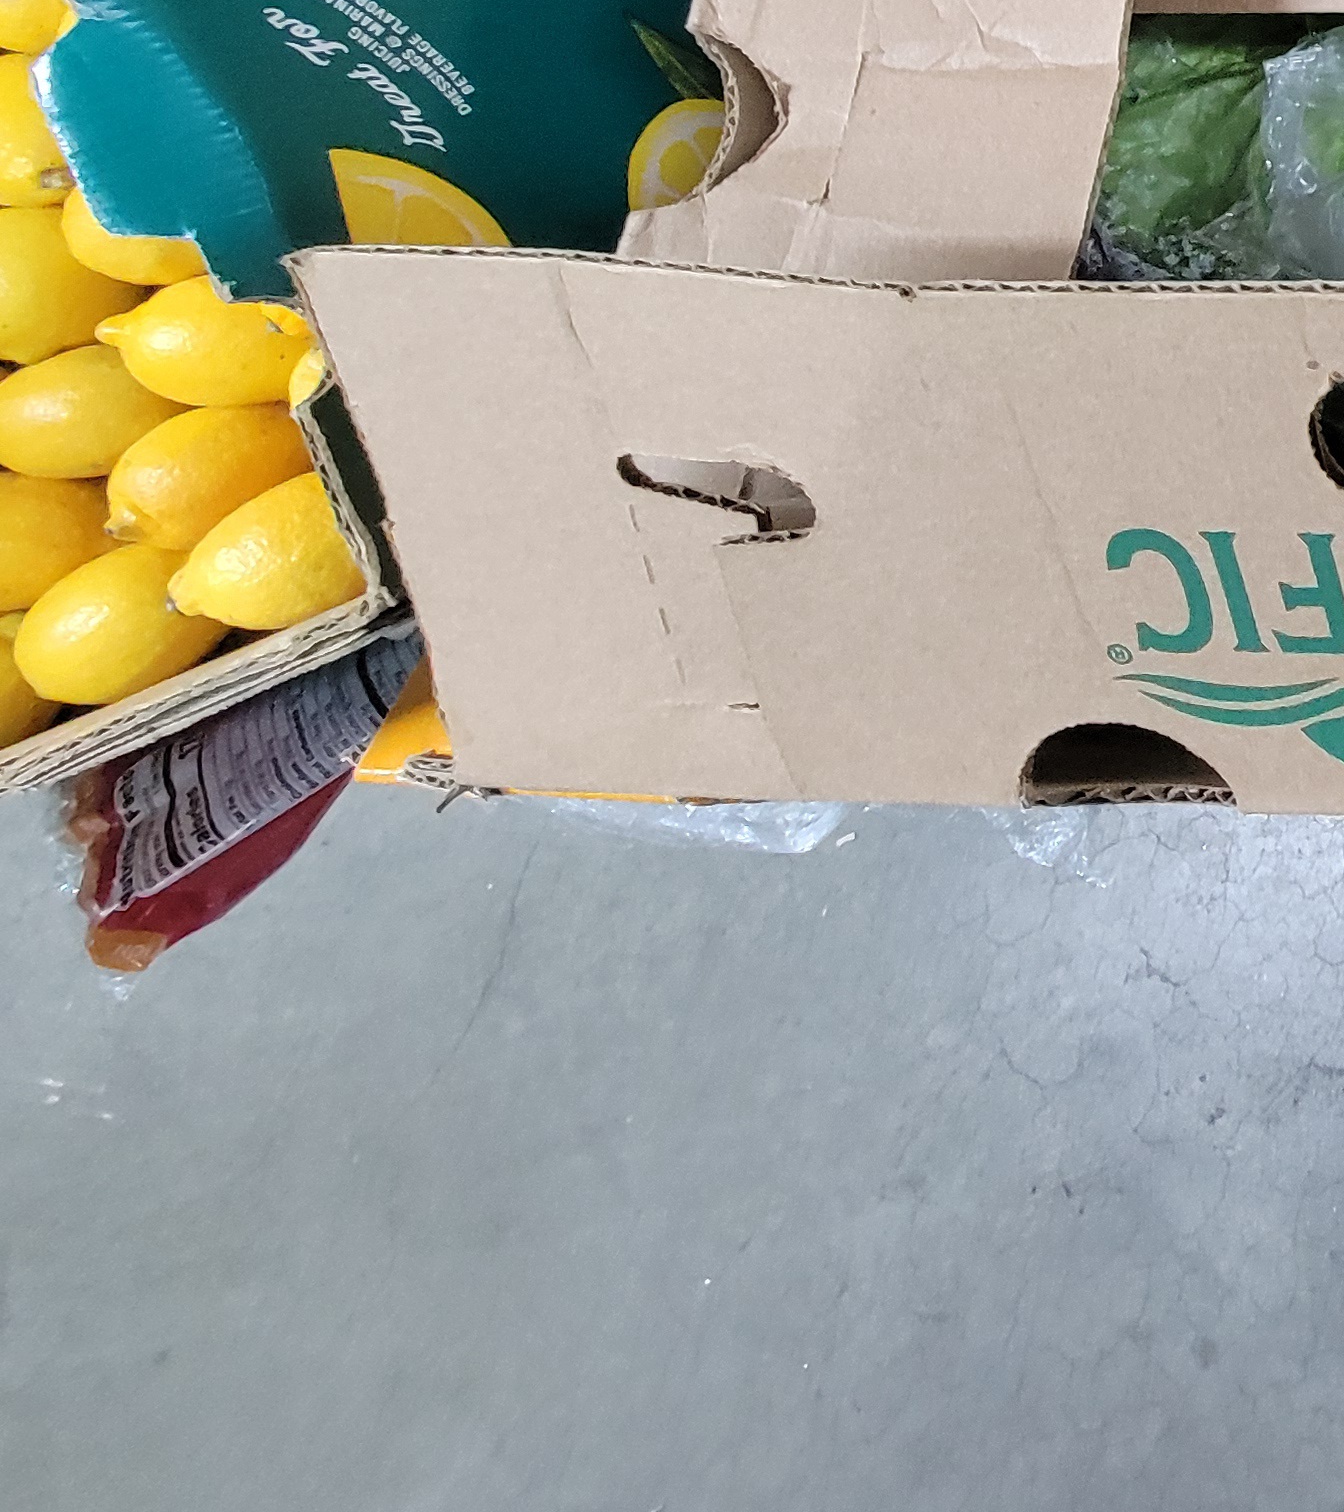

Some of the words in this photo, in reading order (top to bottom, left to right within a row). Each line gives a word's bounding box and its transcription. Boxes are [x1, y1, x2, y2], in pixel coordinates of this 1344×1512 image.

[262, 7, 349, 66] For
[348, 26, 410, 73] JUICING
[408, 33, 475, 95] BEVERAGE
[401, 48, 472, 116] DRESSINGS
